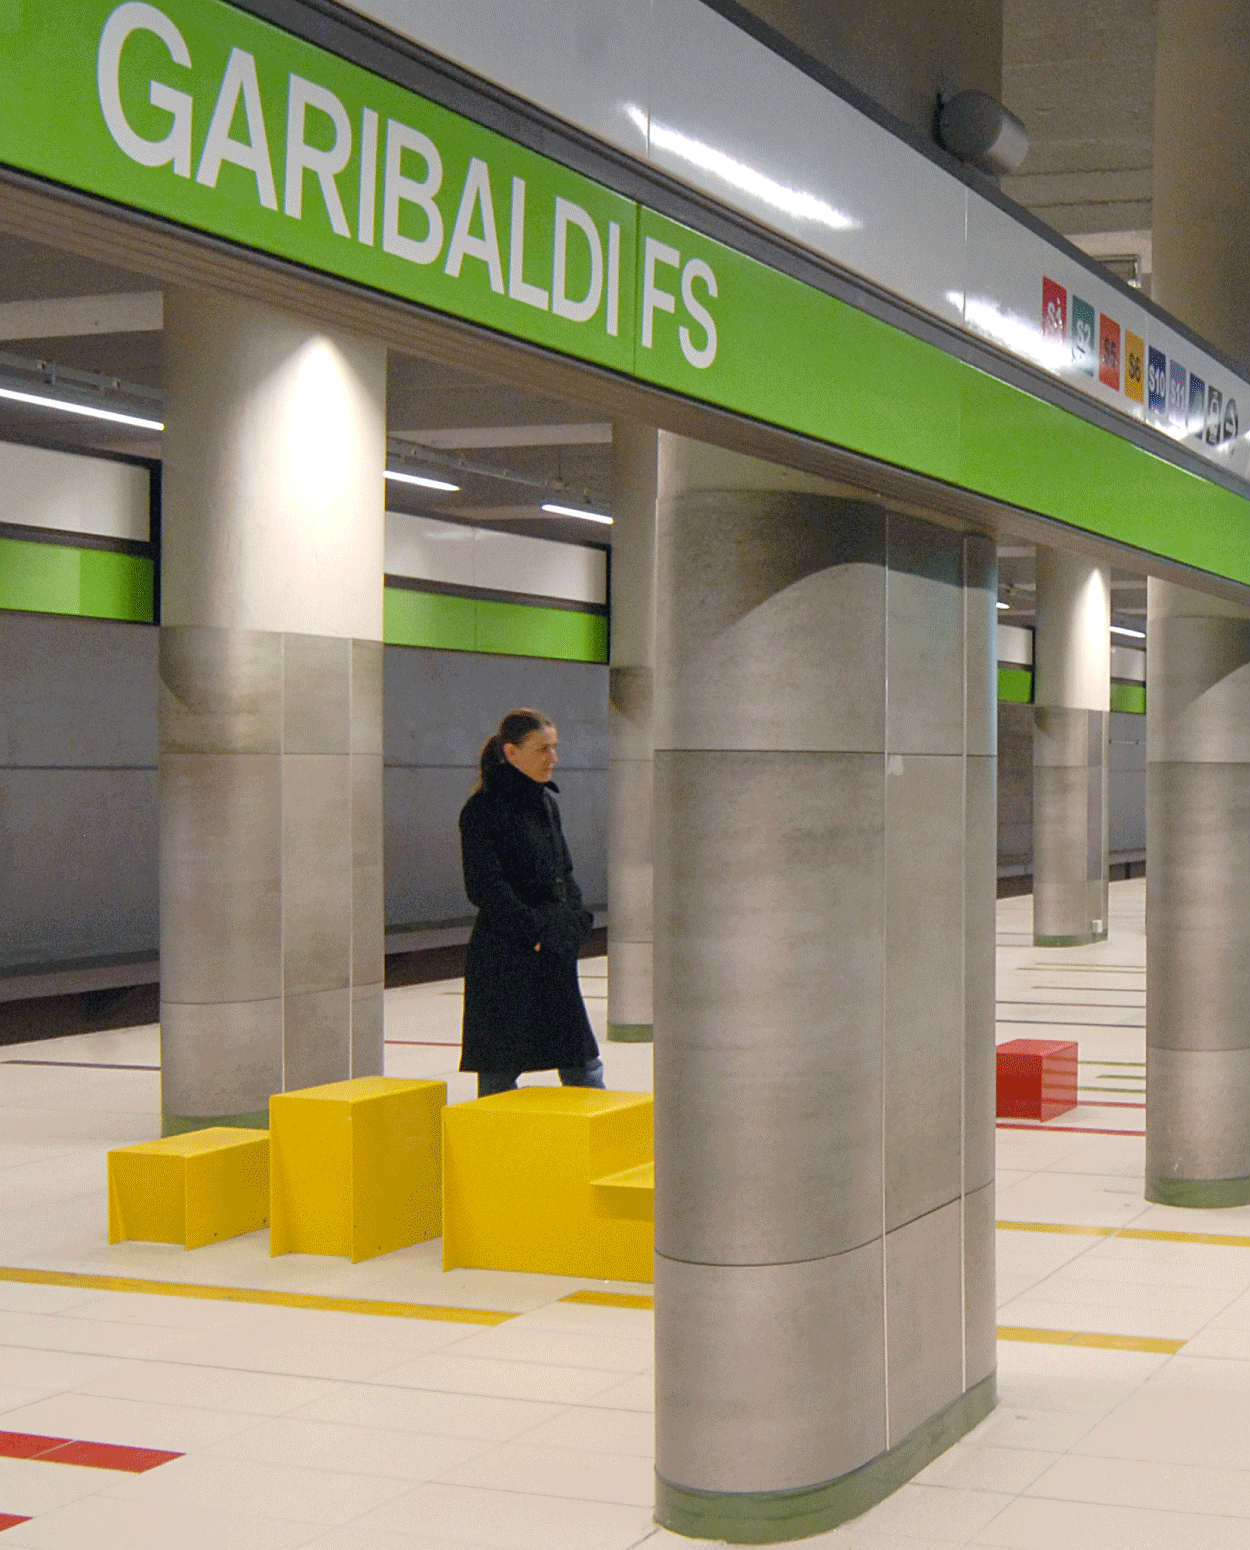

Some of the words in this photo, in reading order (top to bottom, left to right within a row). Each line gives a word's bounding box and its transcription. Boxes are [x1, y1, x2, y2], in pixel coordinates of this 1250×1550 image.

[97, 1, 620, 337] GARIBALDI
[642, 236, 718, 369] FS
[1076, 319, 1091, 351] S2
[1149, 365, 1165, 398] S10
